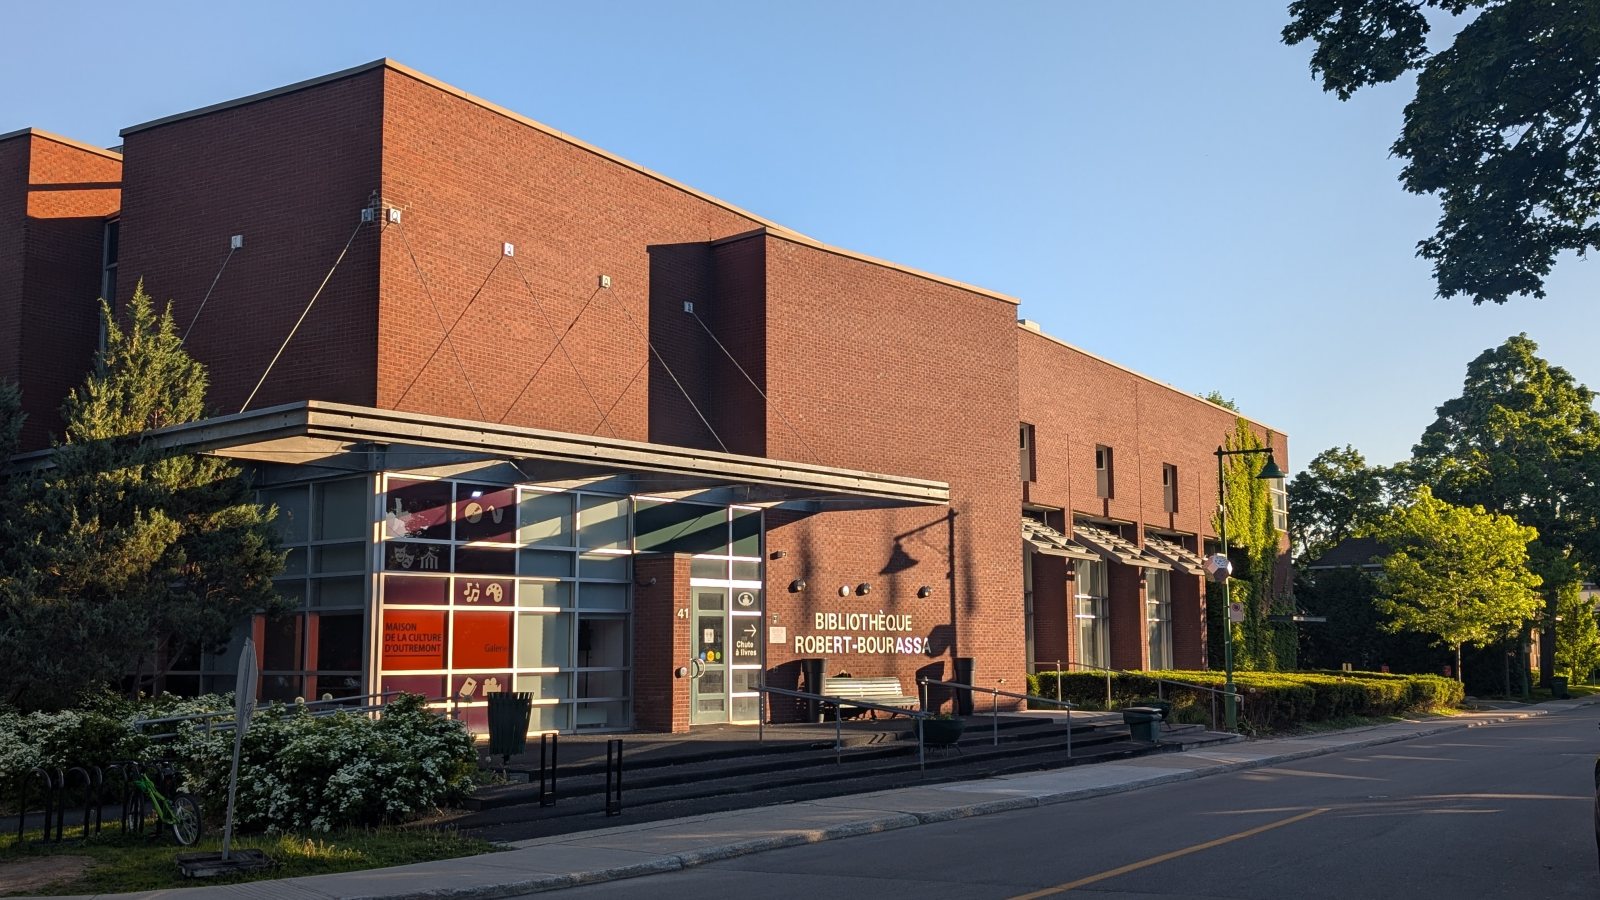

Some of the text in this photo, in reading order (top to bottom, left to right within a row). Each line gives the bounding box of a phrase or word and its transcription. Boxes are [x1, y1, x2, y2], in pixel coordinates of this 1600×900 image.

[677, 608, 689, 619] 41
[815, 610, 912, 631] BIBLIOTHÈQUE
[385, 622, 416, 631] MAISON
[385, 633, 442, 642] DE LA CULTURE
[736, 640, 754, 648] Chute
[795, 636, 931, 654] ROBERT-BOURASSA
[741, 648, 757, 656] livres
